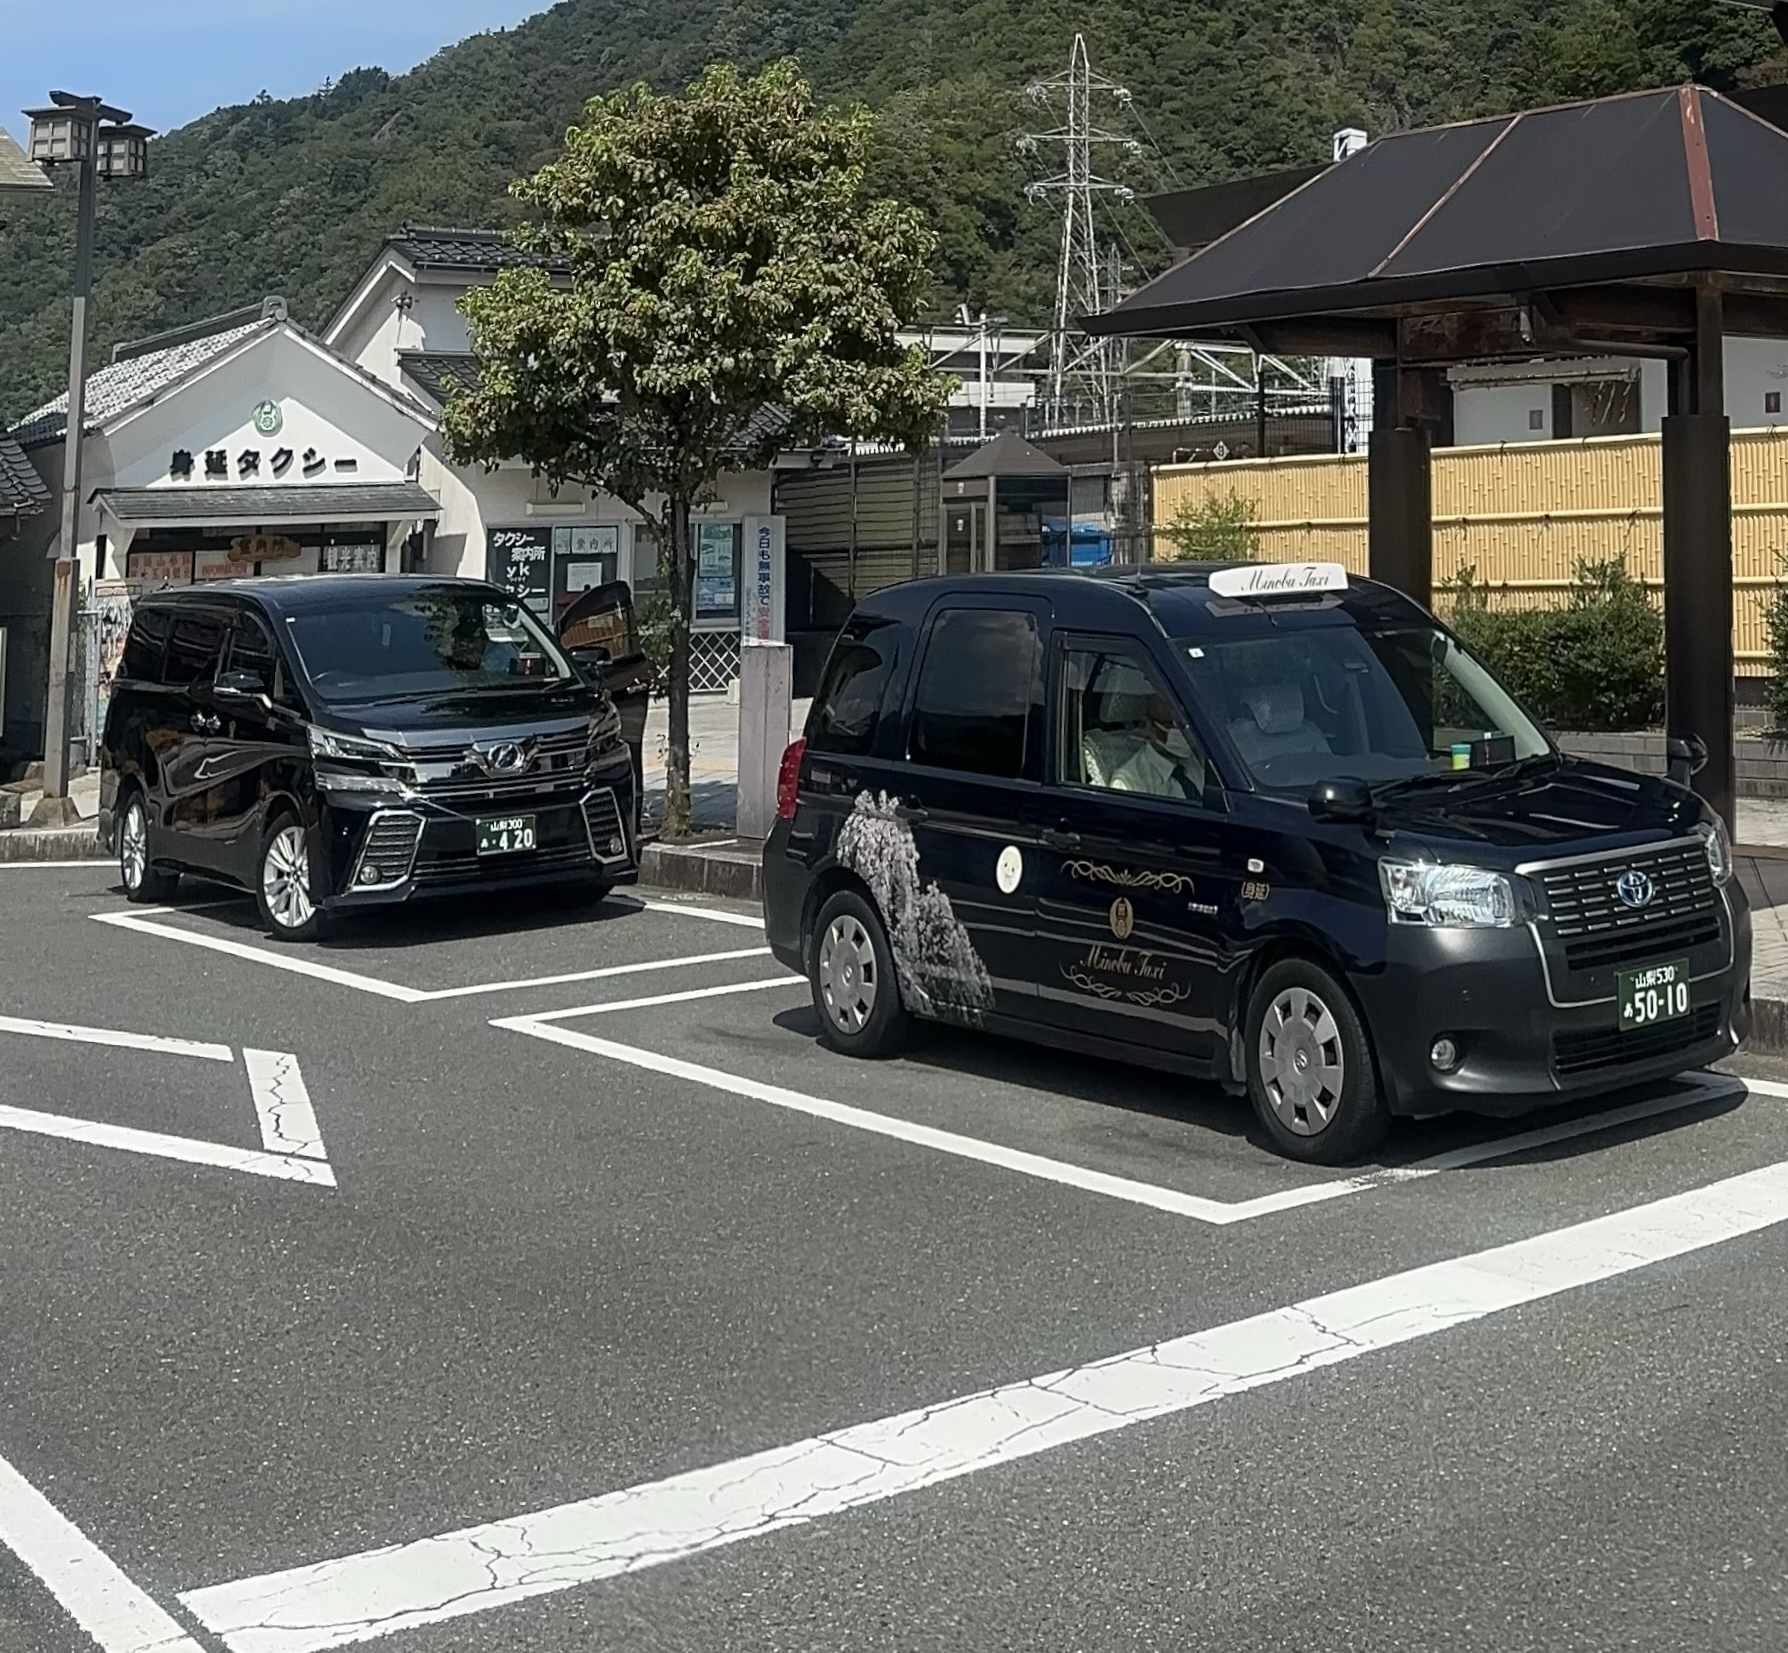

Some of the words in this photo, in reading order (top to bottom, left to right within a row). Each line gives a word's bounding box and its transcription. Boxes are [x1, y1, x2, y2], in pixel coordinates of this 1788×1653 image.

[170, 448, 357, 479] 身延タクシー
[493, 532, 535, 546] タクシー
[511, 546, 546, 561] 案内所
[506, 563, 530, 578] yk
[1241, 568, 1296, 591] Minobu
[1299, 566, 1330, 586] Taxi
[1080, 945, 1131, 975] Minobu
[1133, 951, 1167, 980] Taxi
[1634, 982, 1687, 1023] 50-10
